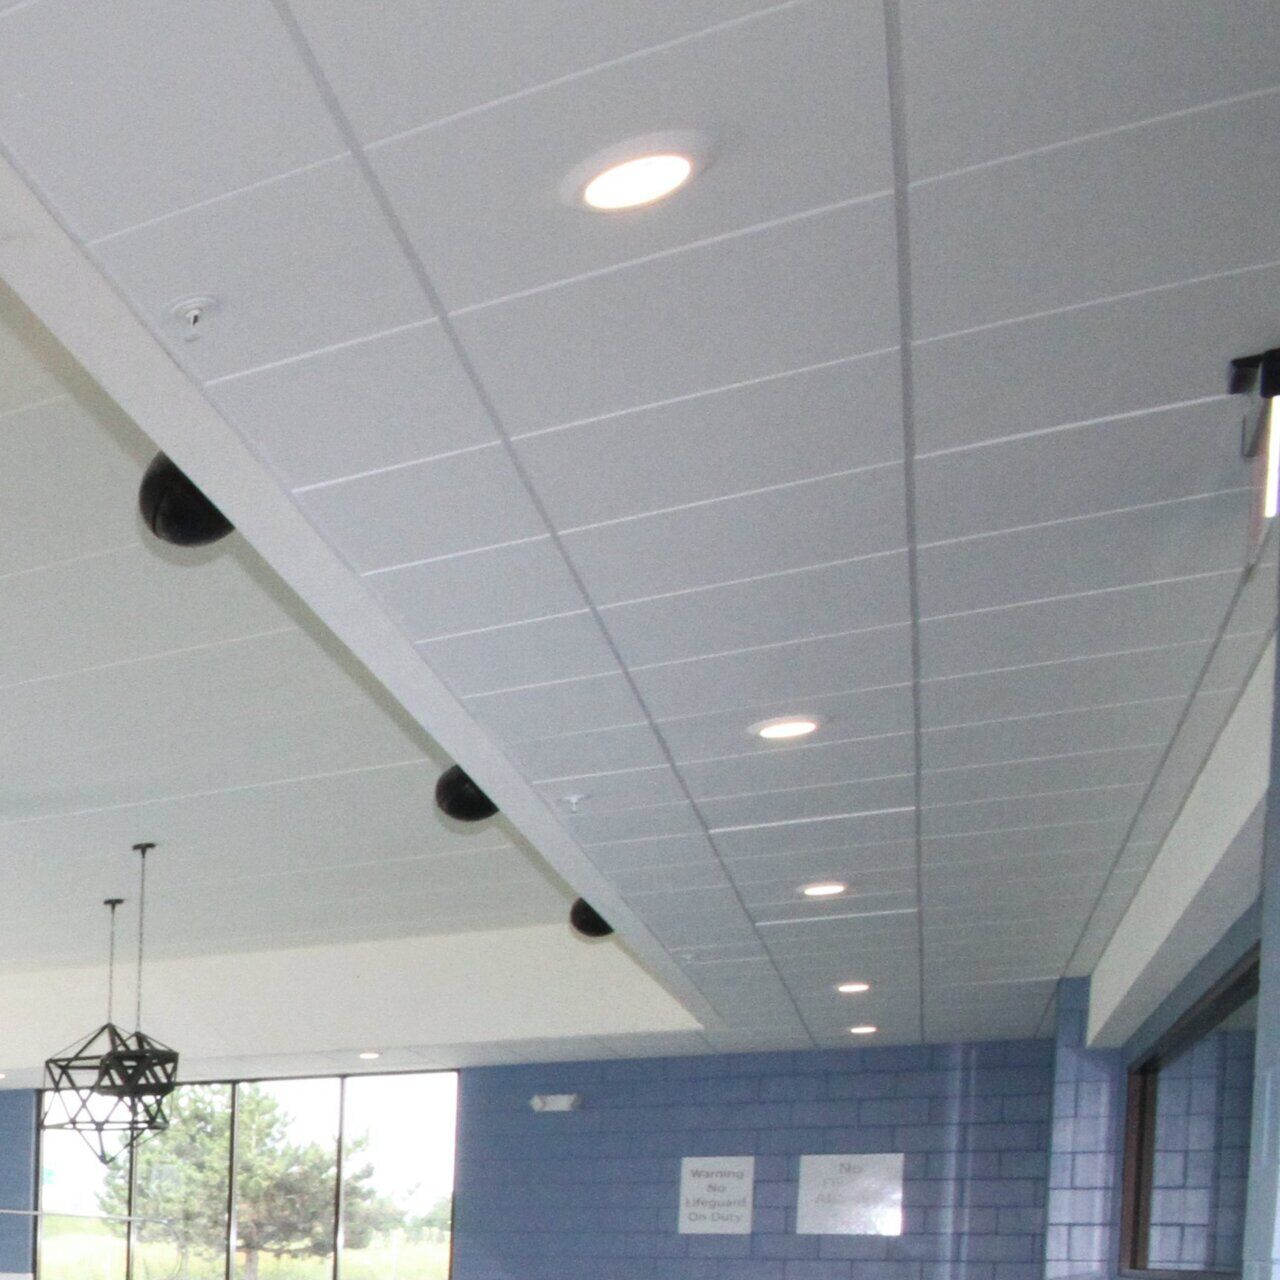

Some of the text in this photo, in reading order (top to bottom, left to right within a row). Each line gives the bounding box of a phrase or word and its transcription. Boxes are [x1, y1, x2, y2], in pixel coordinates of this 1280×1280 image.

[838, 1162, 863, 1174] No
[690, 1169, 745, 1180] Warning
[706, 1183, 727, 1193] No
[685, 1197, 747, 1209] Lifeguard
[687, 1211, 742, 1223] On Duty
